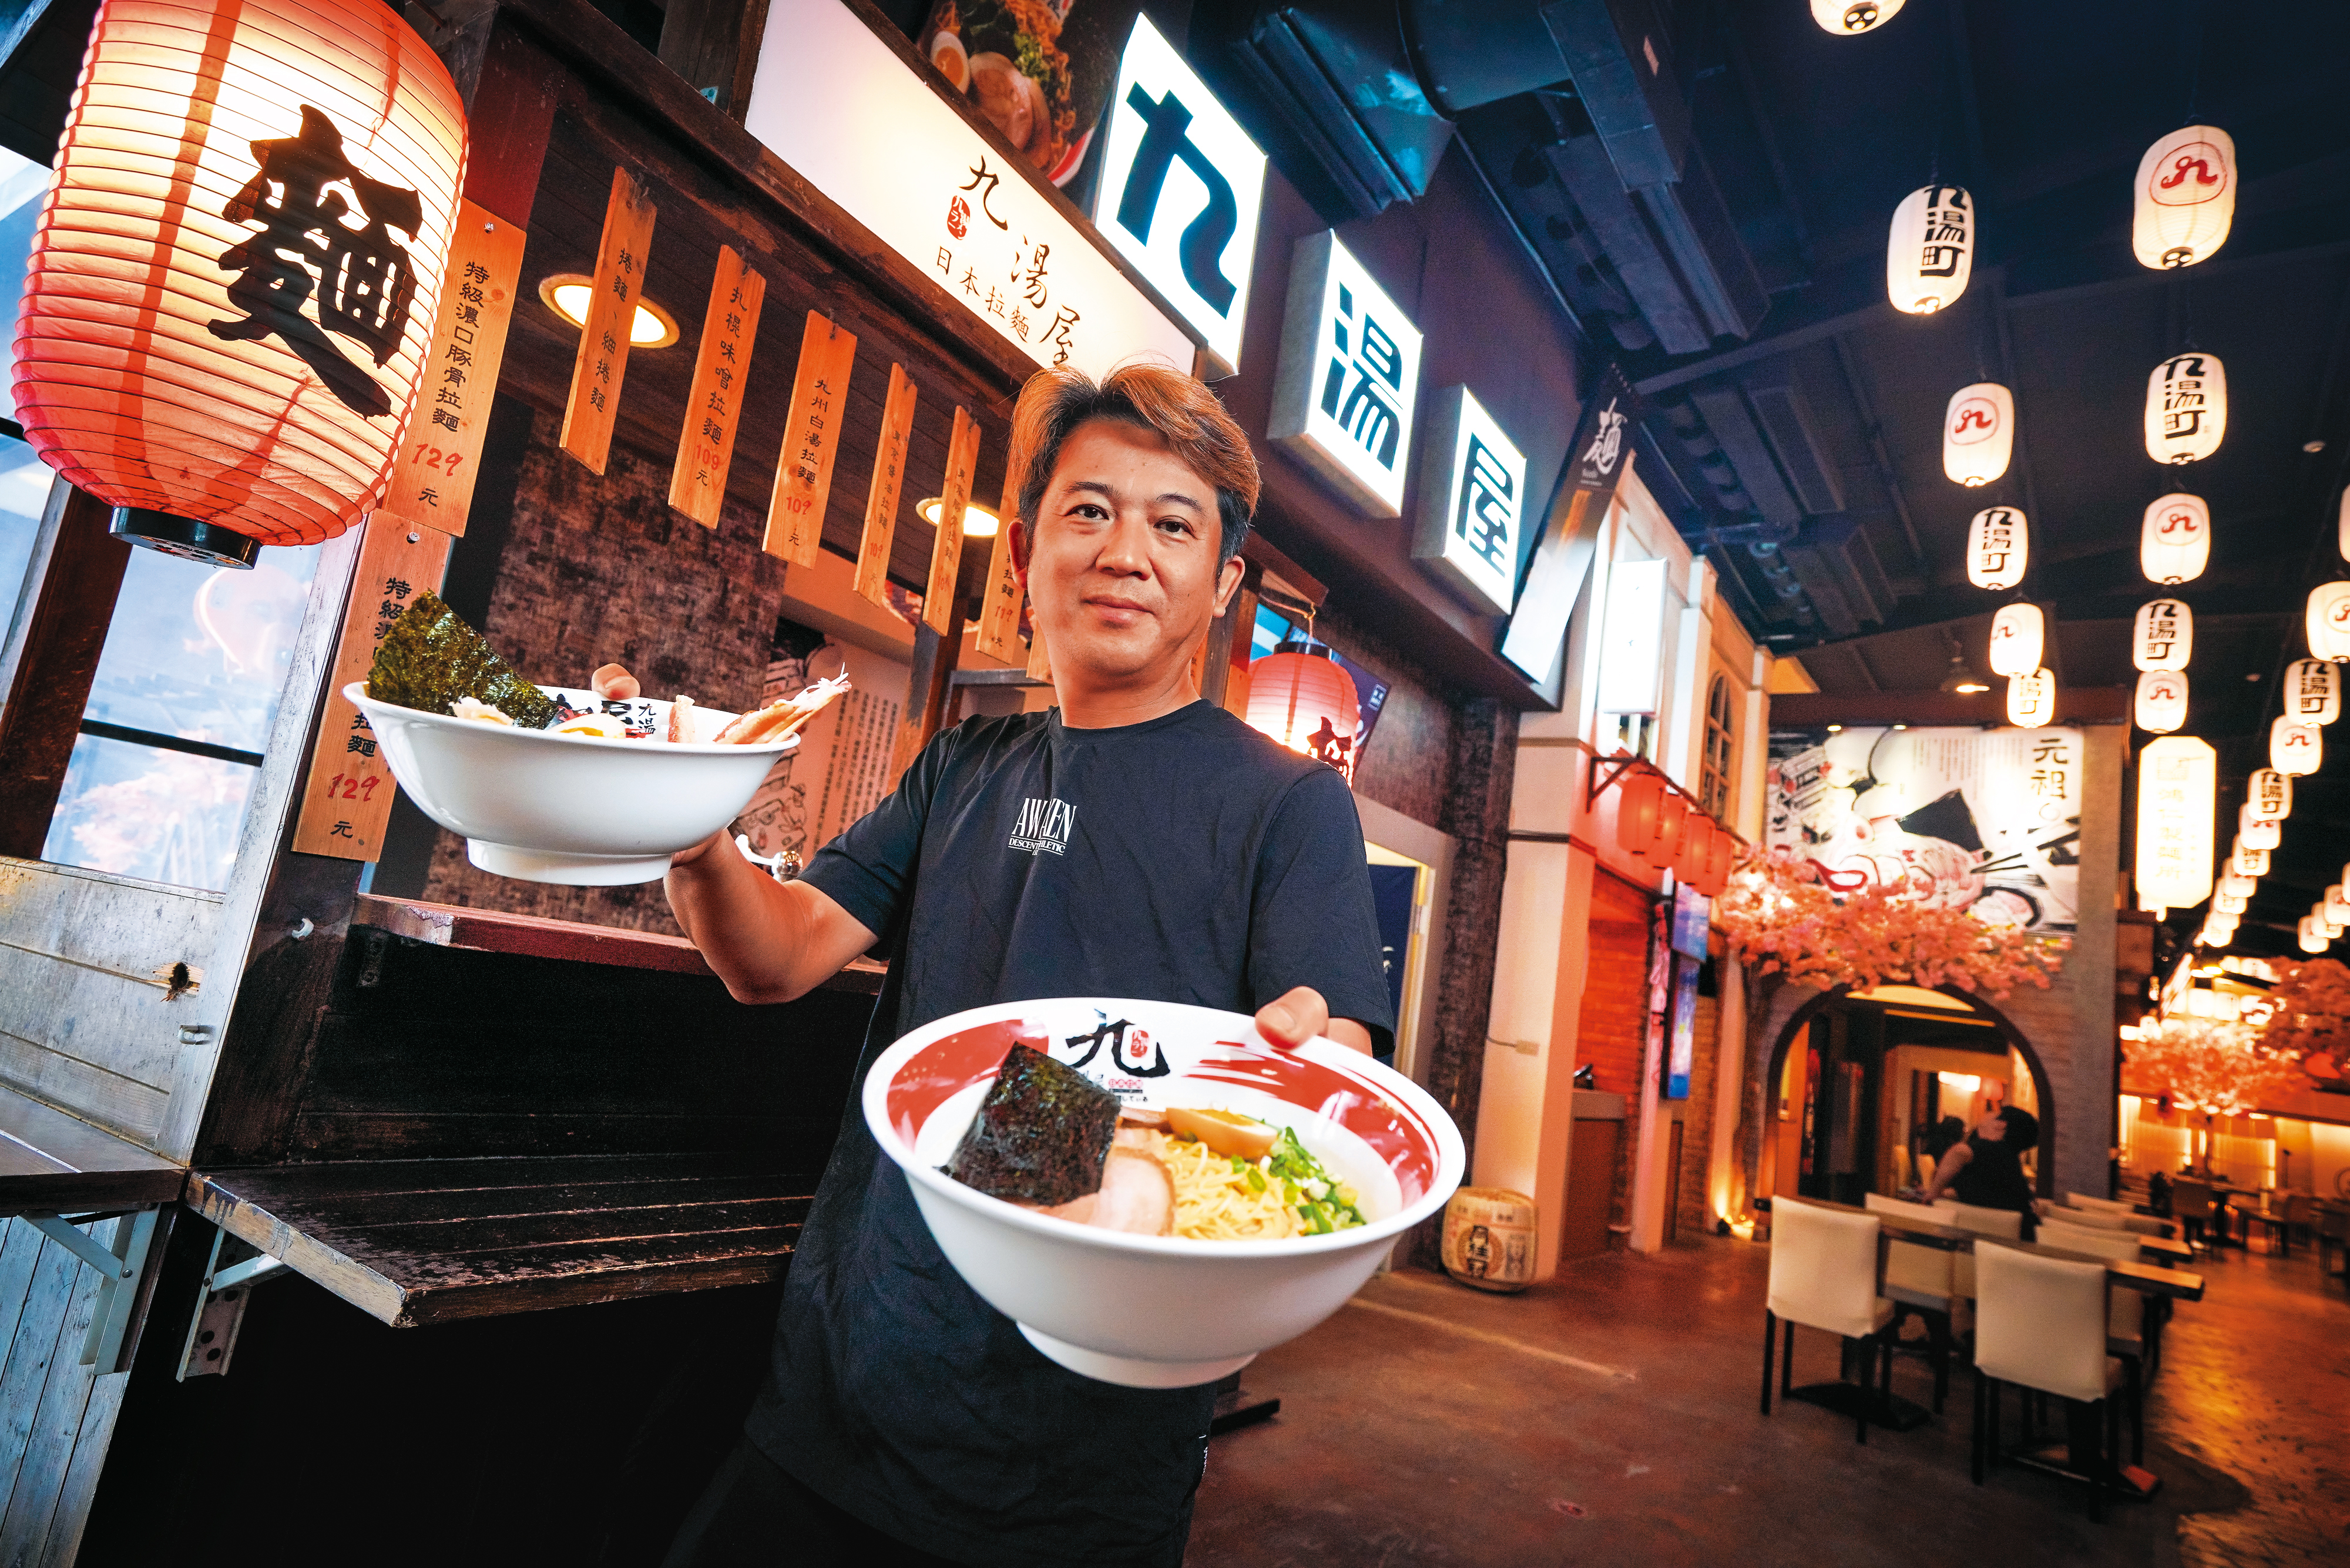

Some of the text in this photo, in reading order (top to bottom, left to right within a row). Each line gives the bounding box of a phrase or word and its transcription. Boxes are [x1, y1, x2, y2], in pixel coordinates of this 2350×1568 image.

[207, 104, 422, 419] 麵
[959, 155, 1080, 365] 九湯屋
[1921, 185, 1967, 277] 九湯町
[937, 246, 1029, 343] 日本拉麵
[412, 261, 490, 507] 特級濃口豚骨拉麵 129 元
[2164, 357, 2206, 439] 九湯町
[696, 444, 720, 471] 109
[696, 469, 708, 486] 元
[787, 380, 831, 546] 九州白湯拉麵 109 元
[1982, 510, 2012, 573] 九湯町
[2147, 603, 2178, 659] 九湯町
[2301, 662, 2330, 714] 九湯町
[328, 773, 380, 801] 129
[330, 821, 353, 838] 元
[1065, 1008, 1170, 1078] 九
